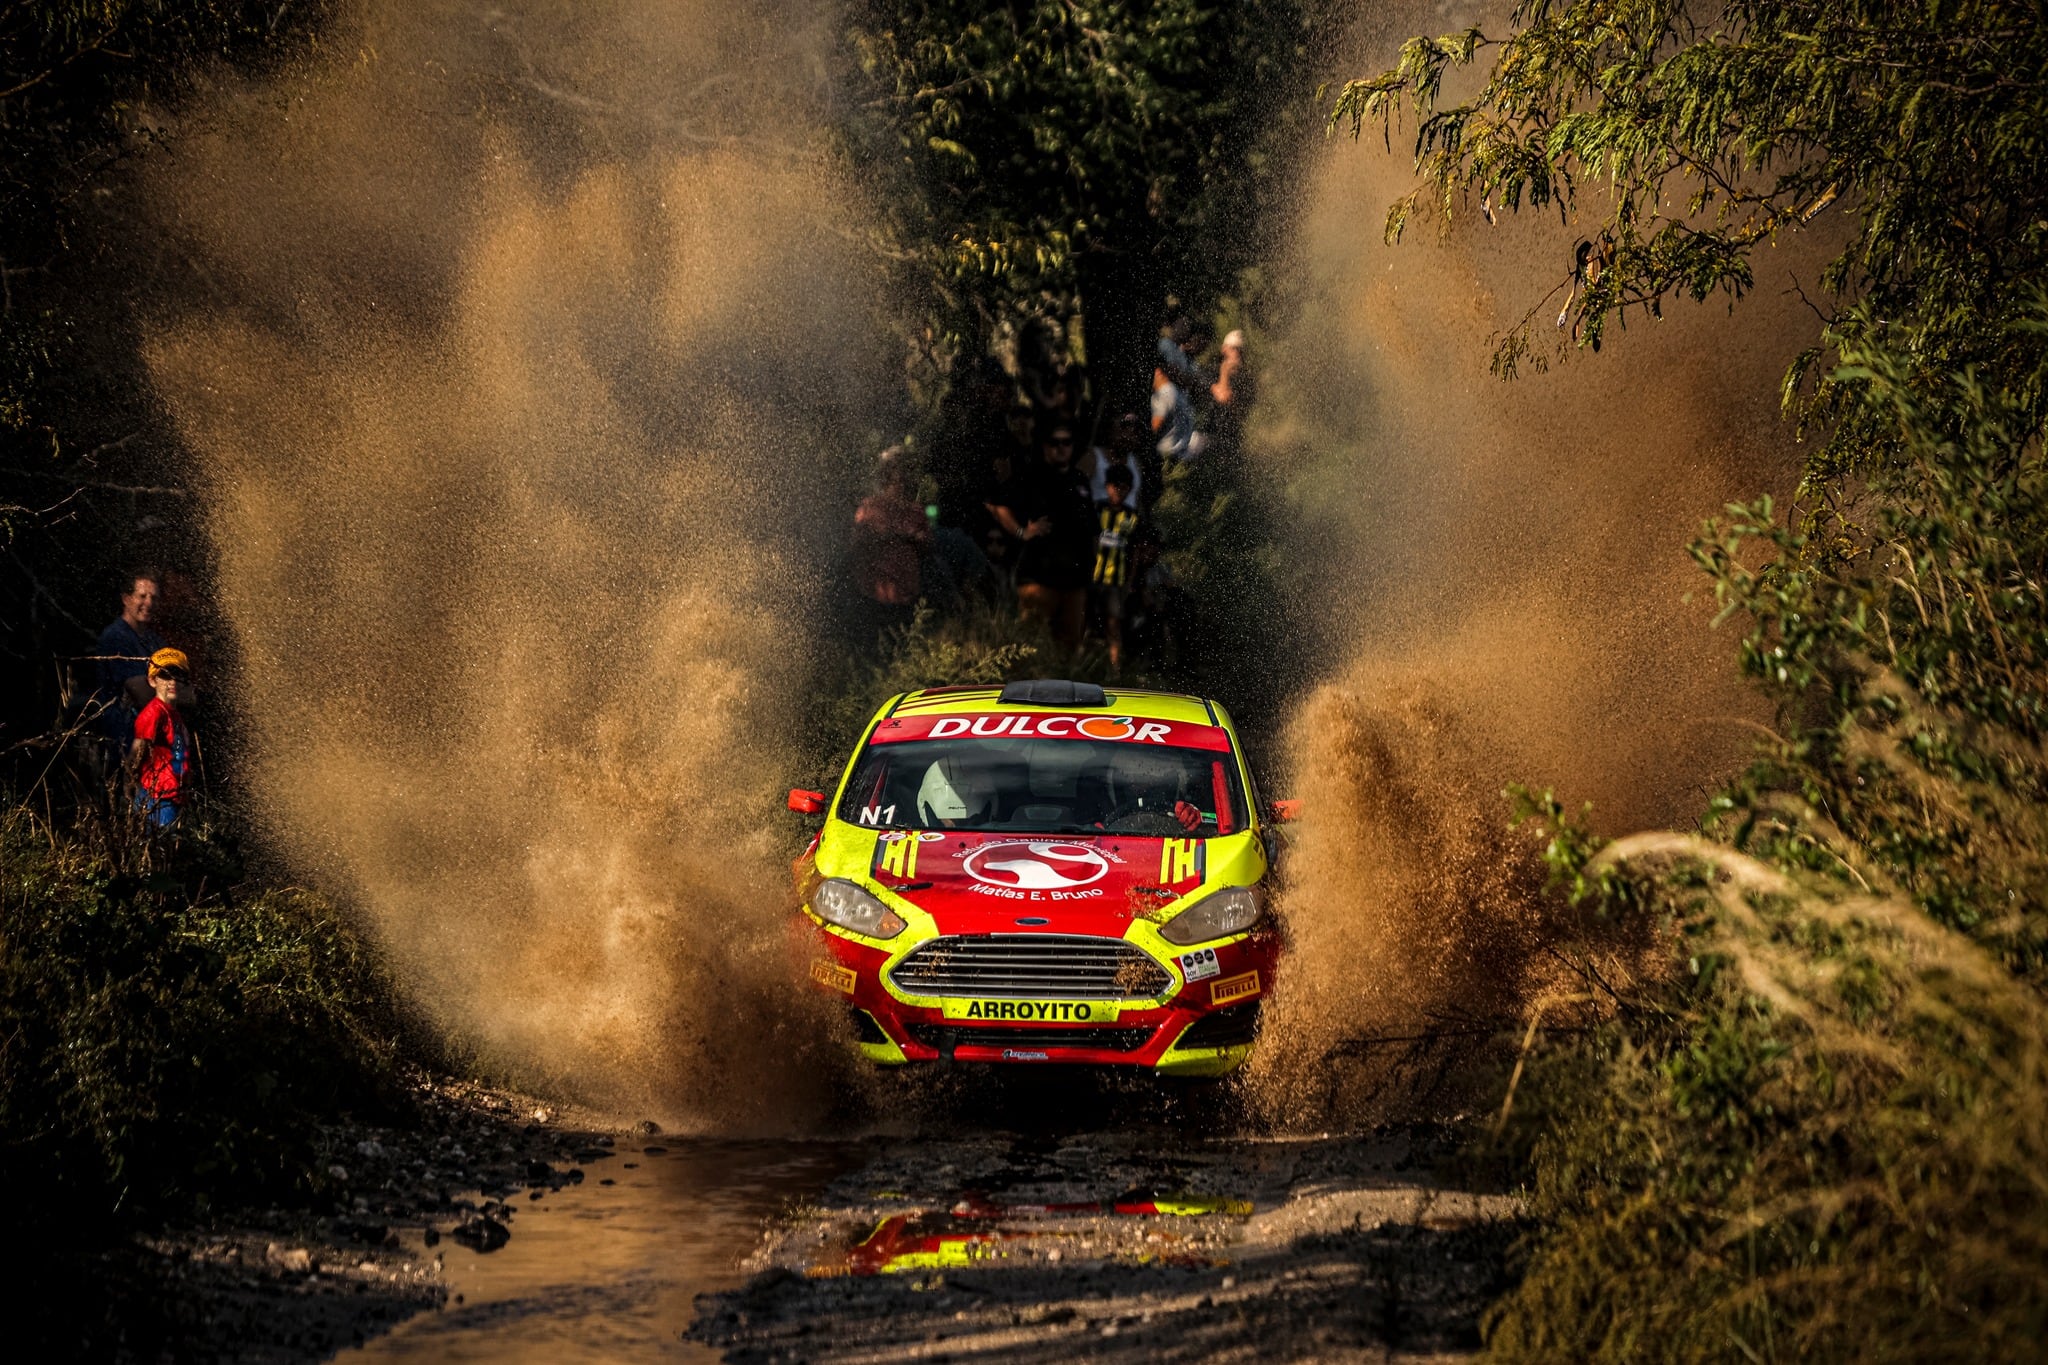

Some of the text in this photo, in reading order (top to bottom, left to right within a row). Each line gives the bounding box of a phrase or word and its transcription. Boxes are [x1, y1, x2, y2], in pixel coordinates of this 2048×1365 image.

[928, 715, 1172, 743] DULCOR
[859, 804, 896, 825] N1
[968, 882, 1104, 901] Matías E. Bruno
[967, 1001, 1092, 1020] ARROYITO
